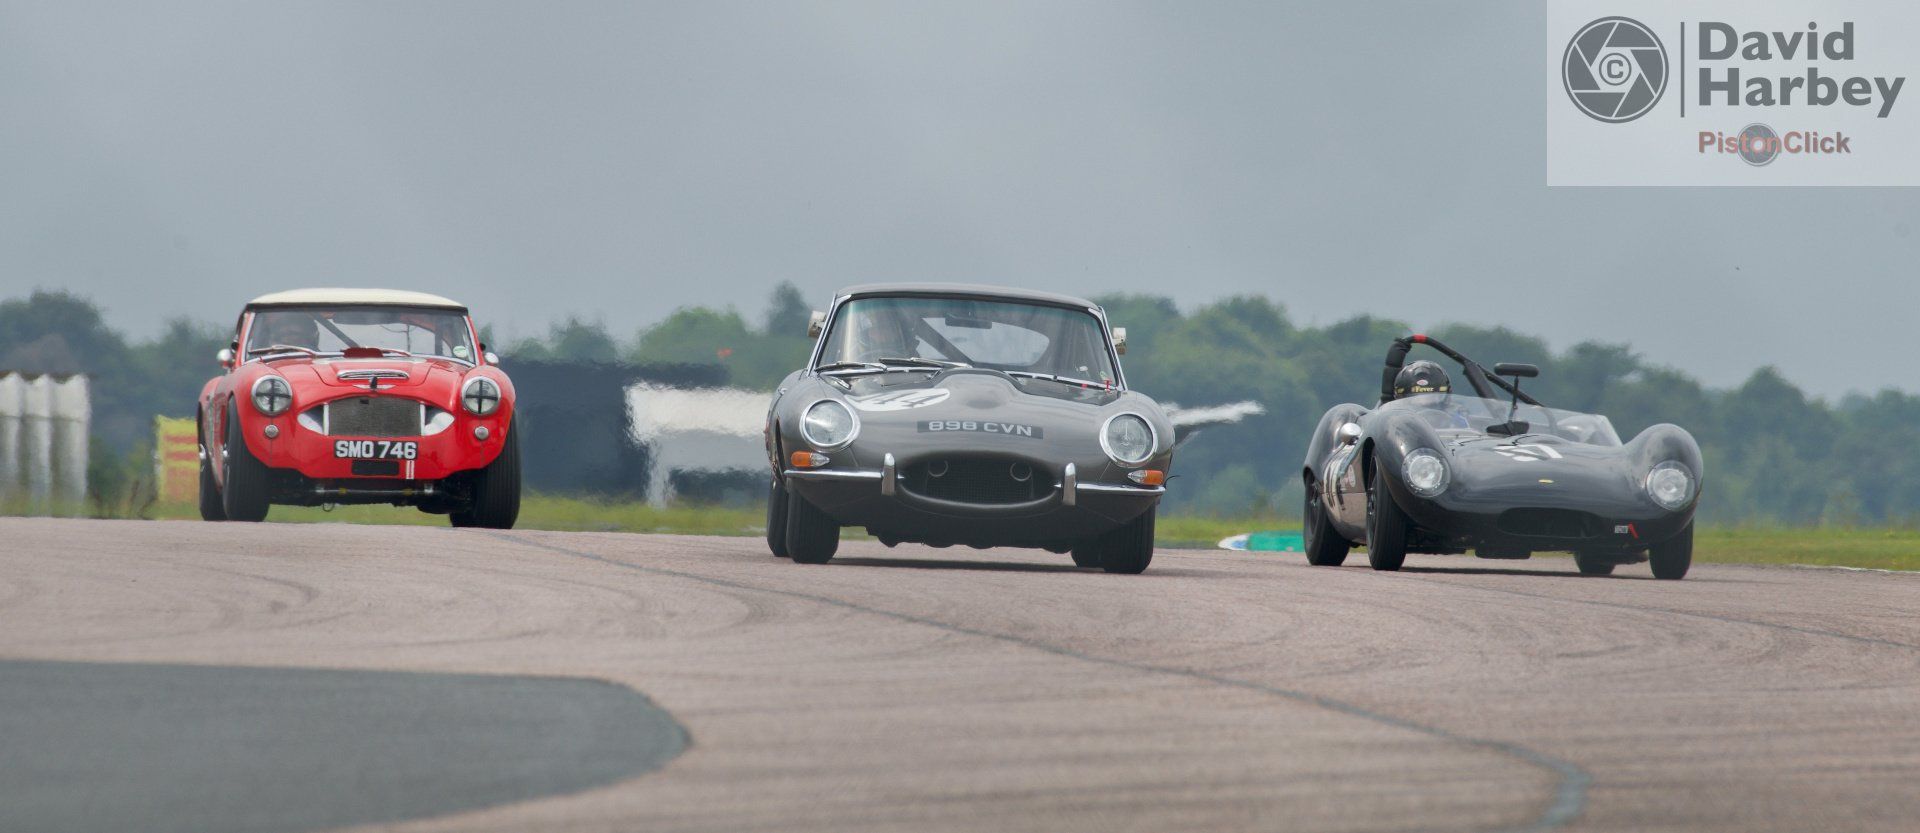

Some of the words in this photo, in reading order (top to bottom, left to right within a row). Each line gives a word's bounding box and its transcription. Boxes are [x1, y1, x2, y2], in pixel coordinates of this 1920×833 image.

[928, 421, 978, 431] 898
[983, 422, 1032, 436] CVN
[335, 440, 375, 458] SMO
[377, 441, 417, 460] 746
